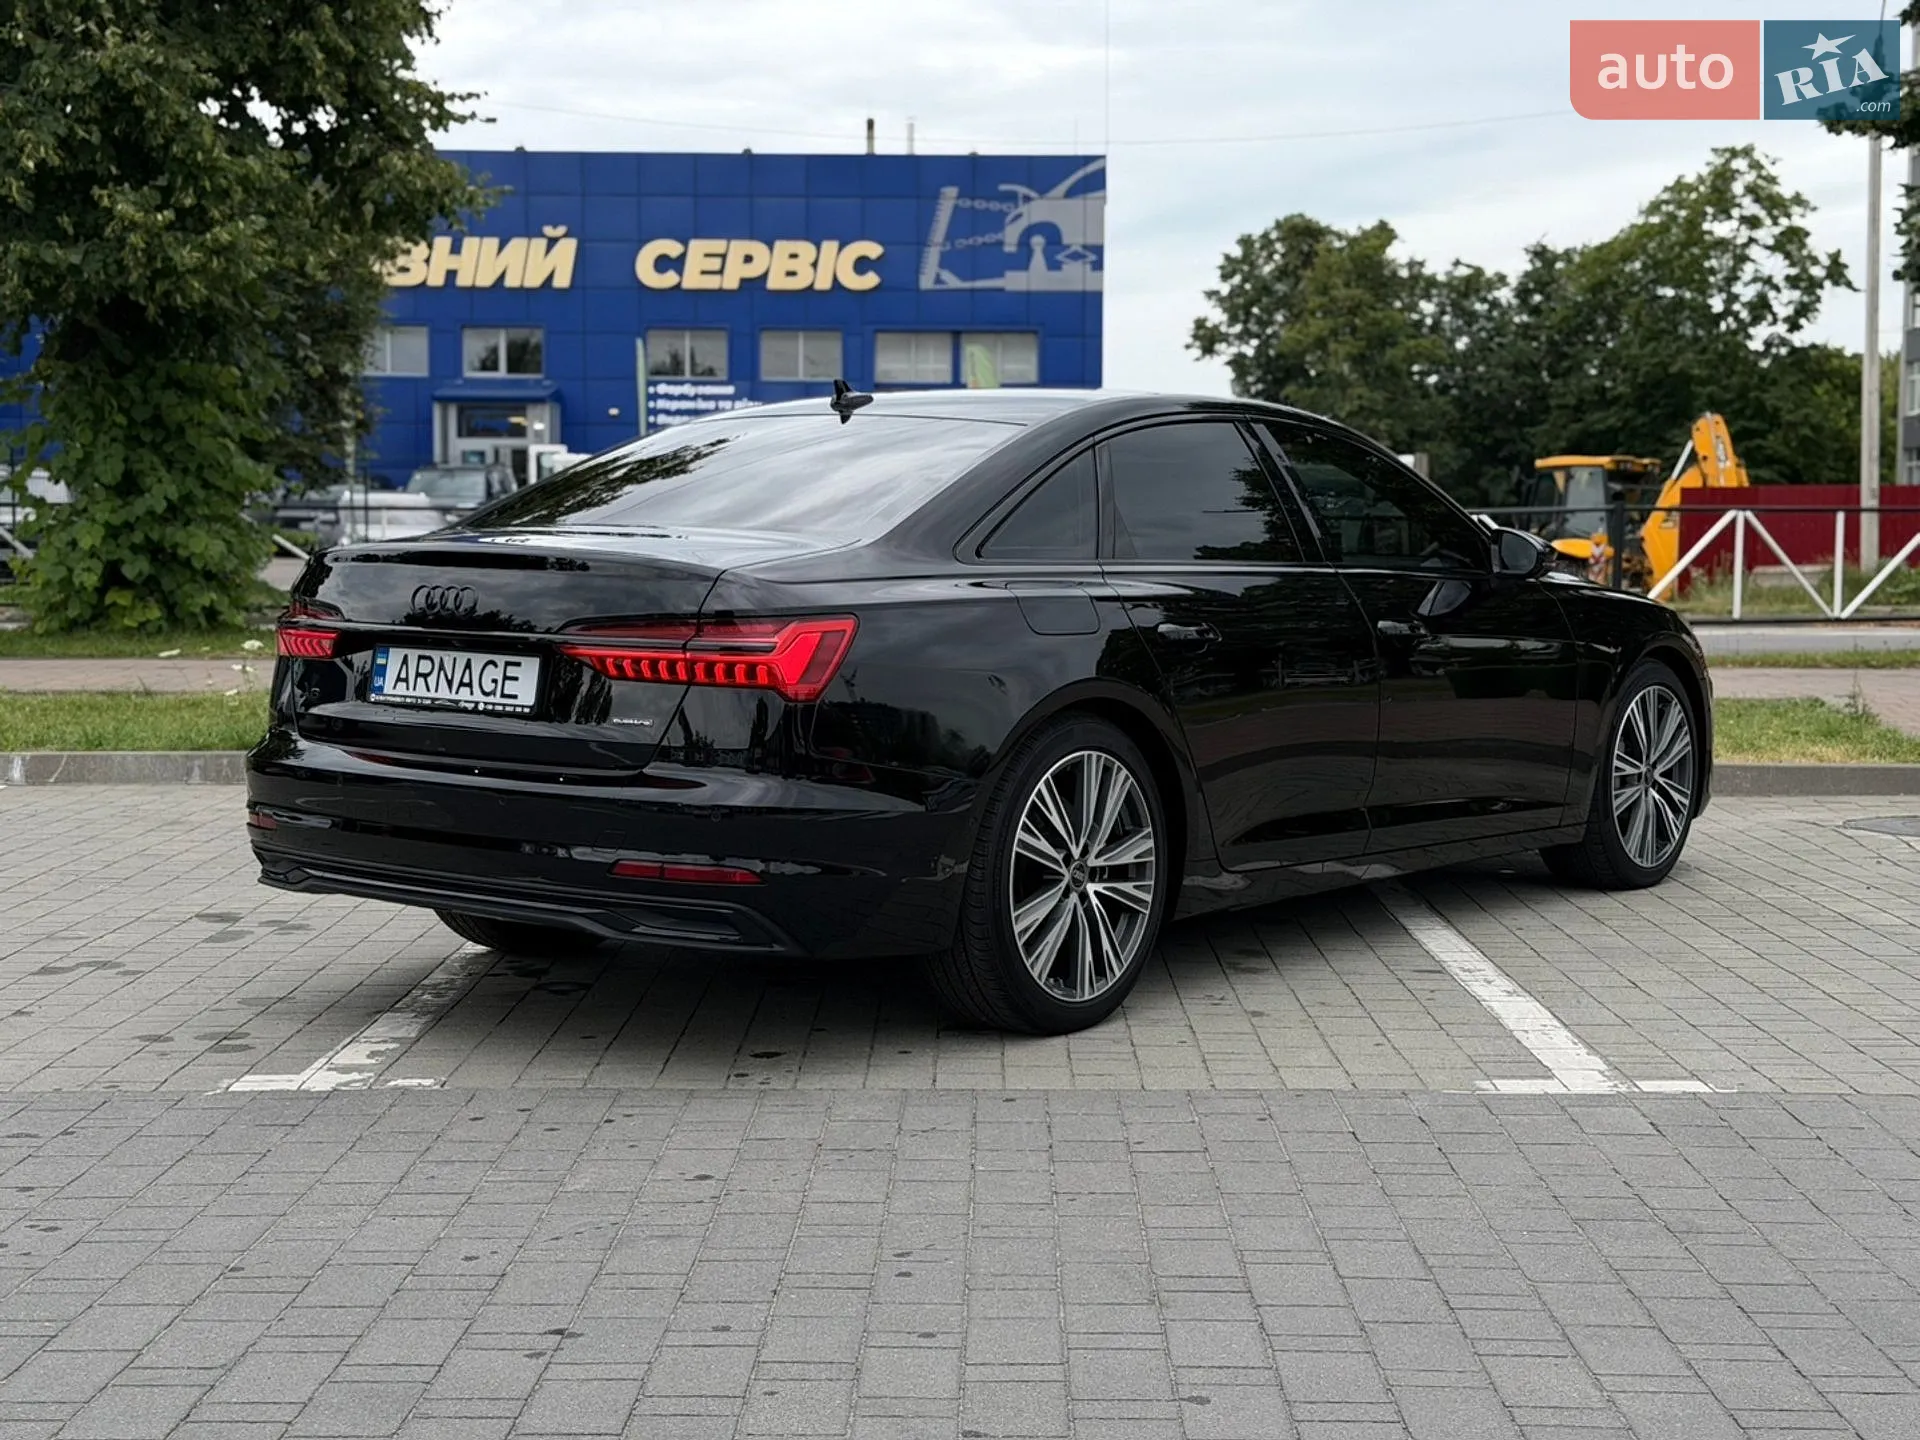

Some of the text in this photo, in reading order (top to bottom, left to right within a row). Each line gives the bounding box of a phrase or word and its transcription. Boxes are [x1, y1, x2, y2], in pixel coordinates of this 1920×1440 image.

[372, 225, 885, 291] ВНИЙ СЕРВІС
[392, 653, 522, 700] ARNAGE
